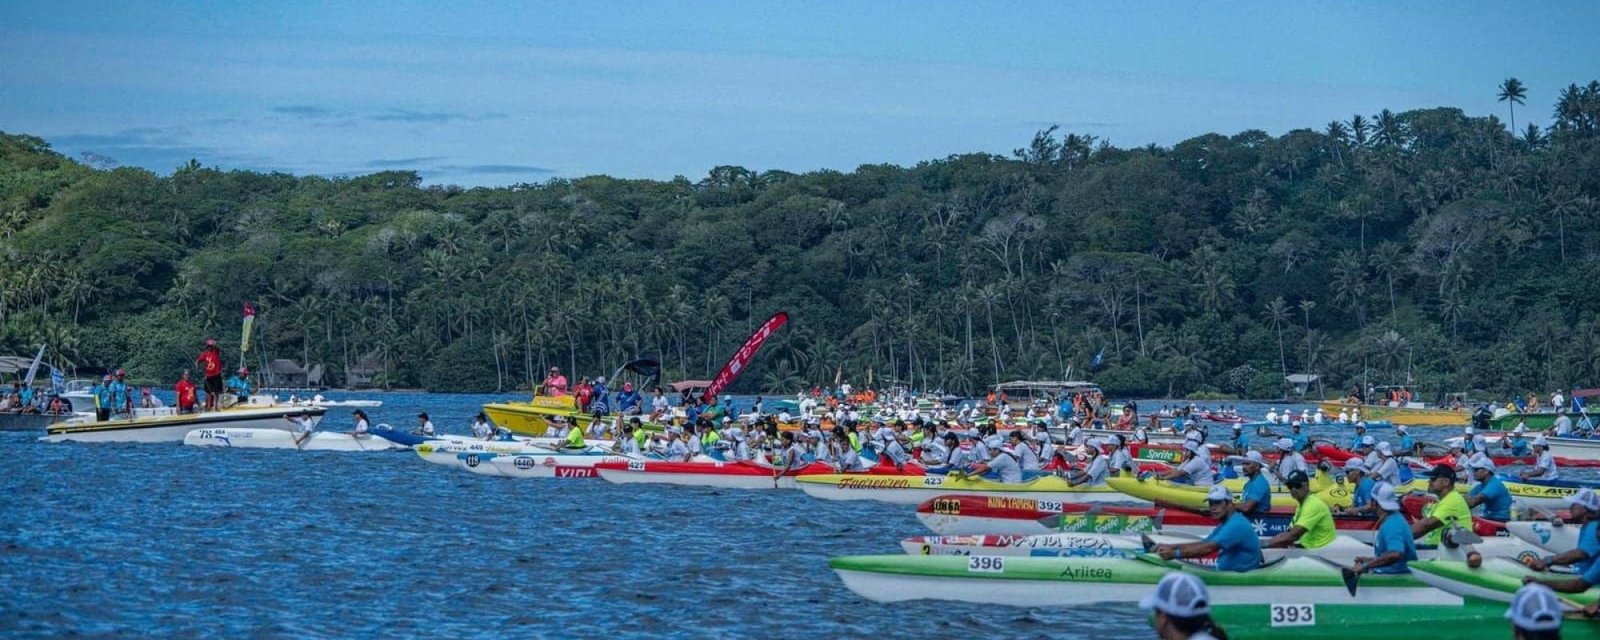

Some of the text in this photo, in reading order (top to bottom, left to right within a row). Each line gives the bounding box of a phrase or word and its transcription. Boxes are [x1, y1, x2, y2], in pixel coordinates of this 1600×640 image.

[1147, 449, 1174, 460] Sprite
[629, 461, 643, 469] 427
[924, 477, 942, 485] 423
[1039, 500, 1062, 511] 392
[970, 557, 1003, 570] 396
[1272, 606, 1313, 622] 393
